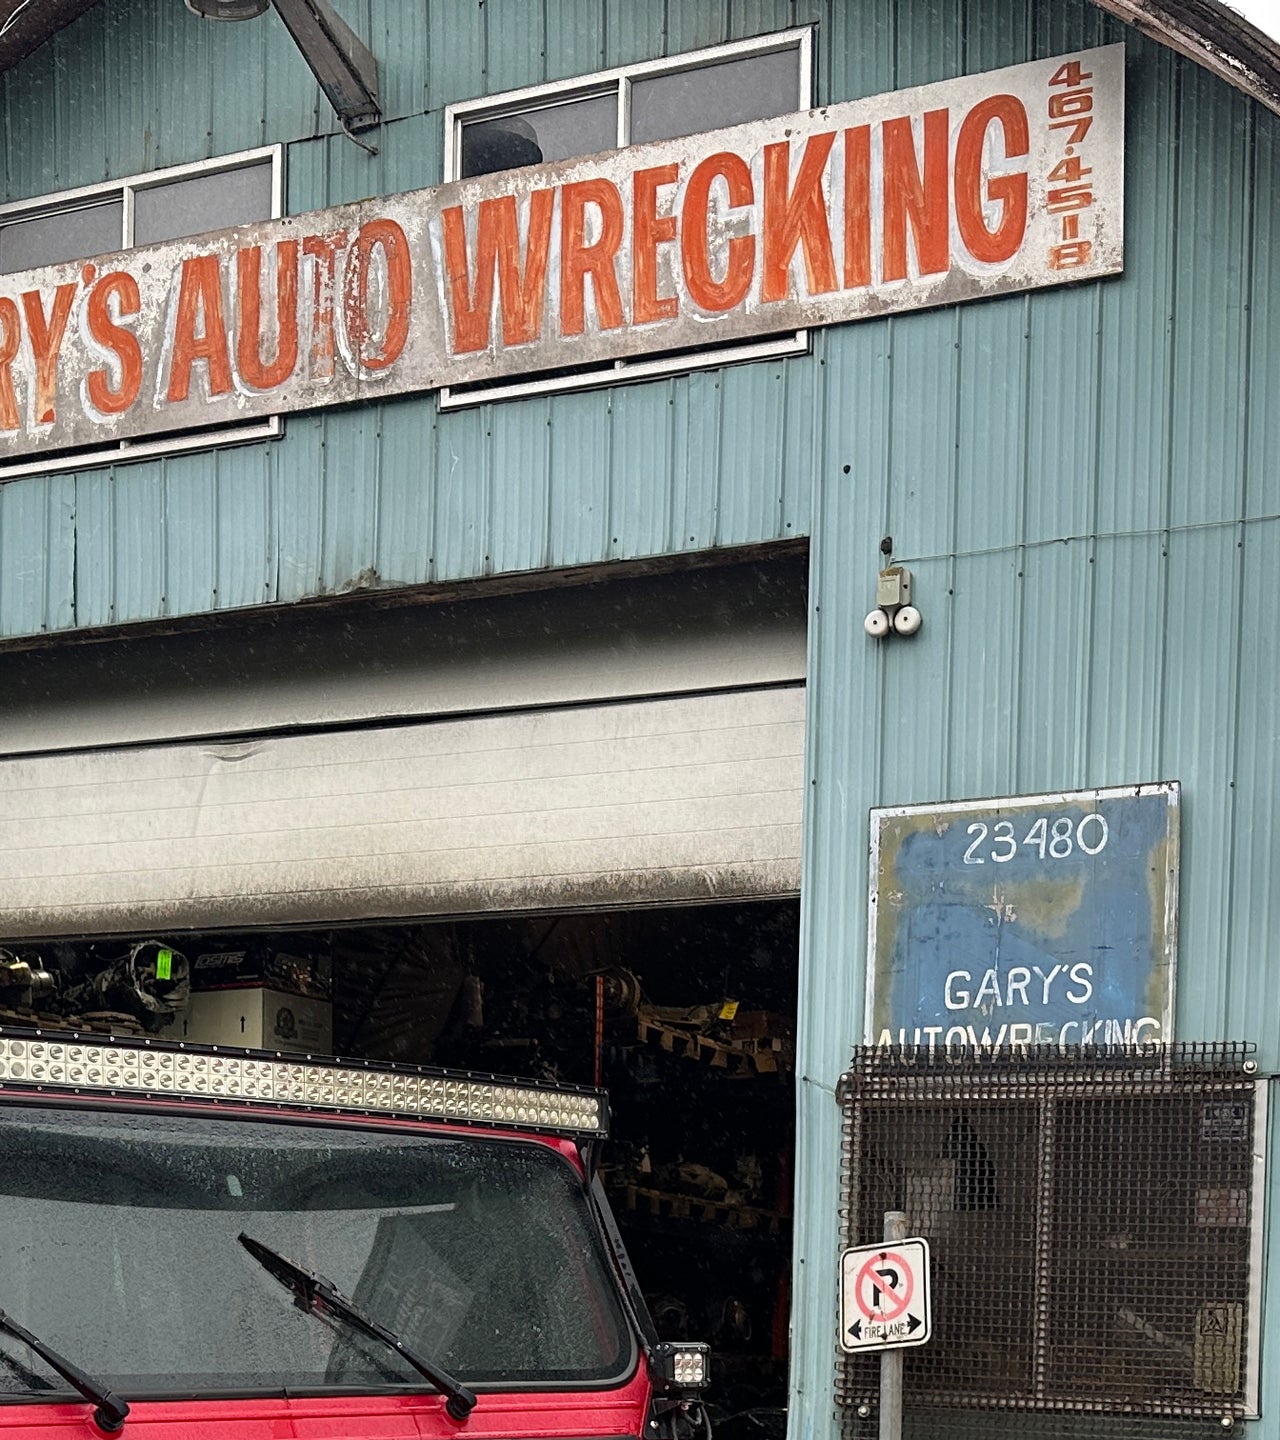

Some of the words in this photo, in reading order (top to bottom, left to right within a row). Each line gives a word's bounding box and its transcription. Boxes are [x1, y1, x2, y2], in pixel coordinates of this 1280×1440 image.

[165, 218, 412, 402] AUTO
[441, 94, 1031, 354] WRECKING
[963, 813, 1109, 864] 23480
[943, 962, 1094, 1010] GARY'S
[864, 1325, 882, 1339] FIRE
